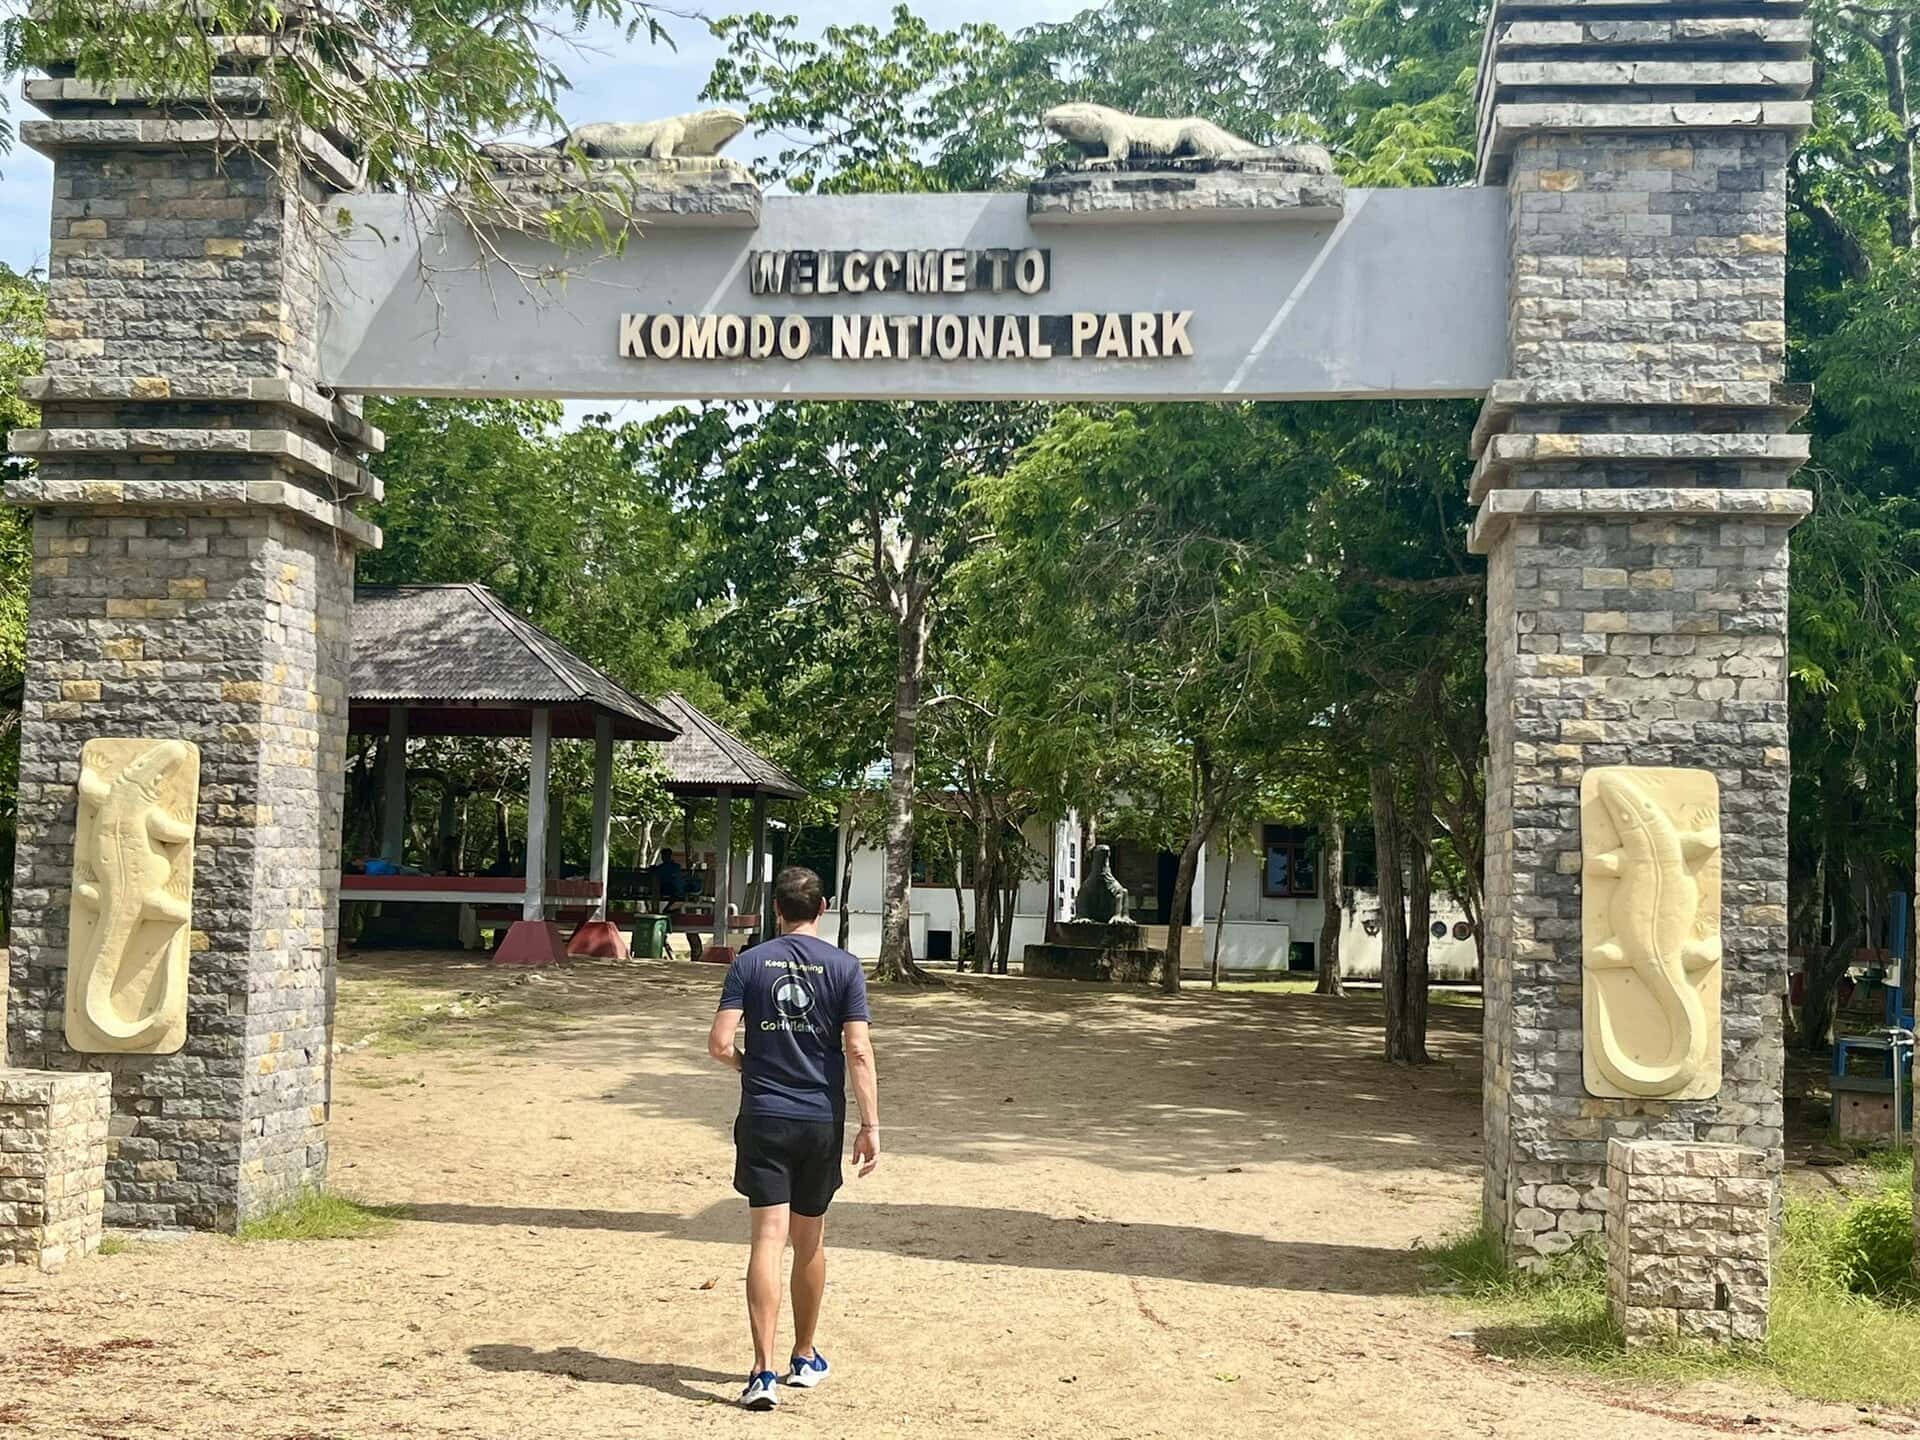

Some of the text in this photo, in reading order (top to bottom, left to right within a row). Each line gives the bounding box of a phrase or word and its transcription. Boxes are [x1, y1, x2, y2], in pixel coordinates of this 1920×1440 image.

[749, 248, 1047, 295] WELCOME TO
[619, 310, 1195, 360] KOMODO NATIONAL PARK
[765, 960, 787, 968] Keep
